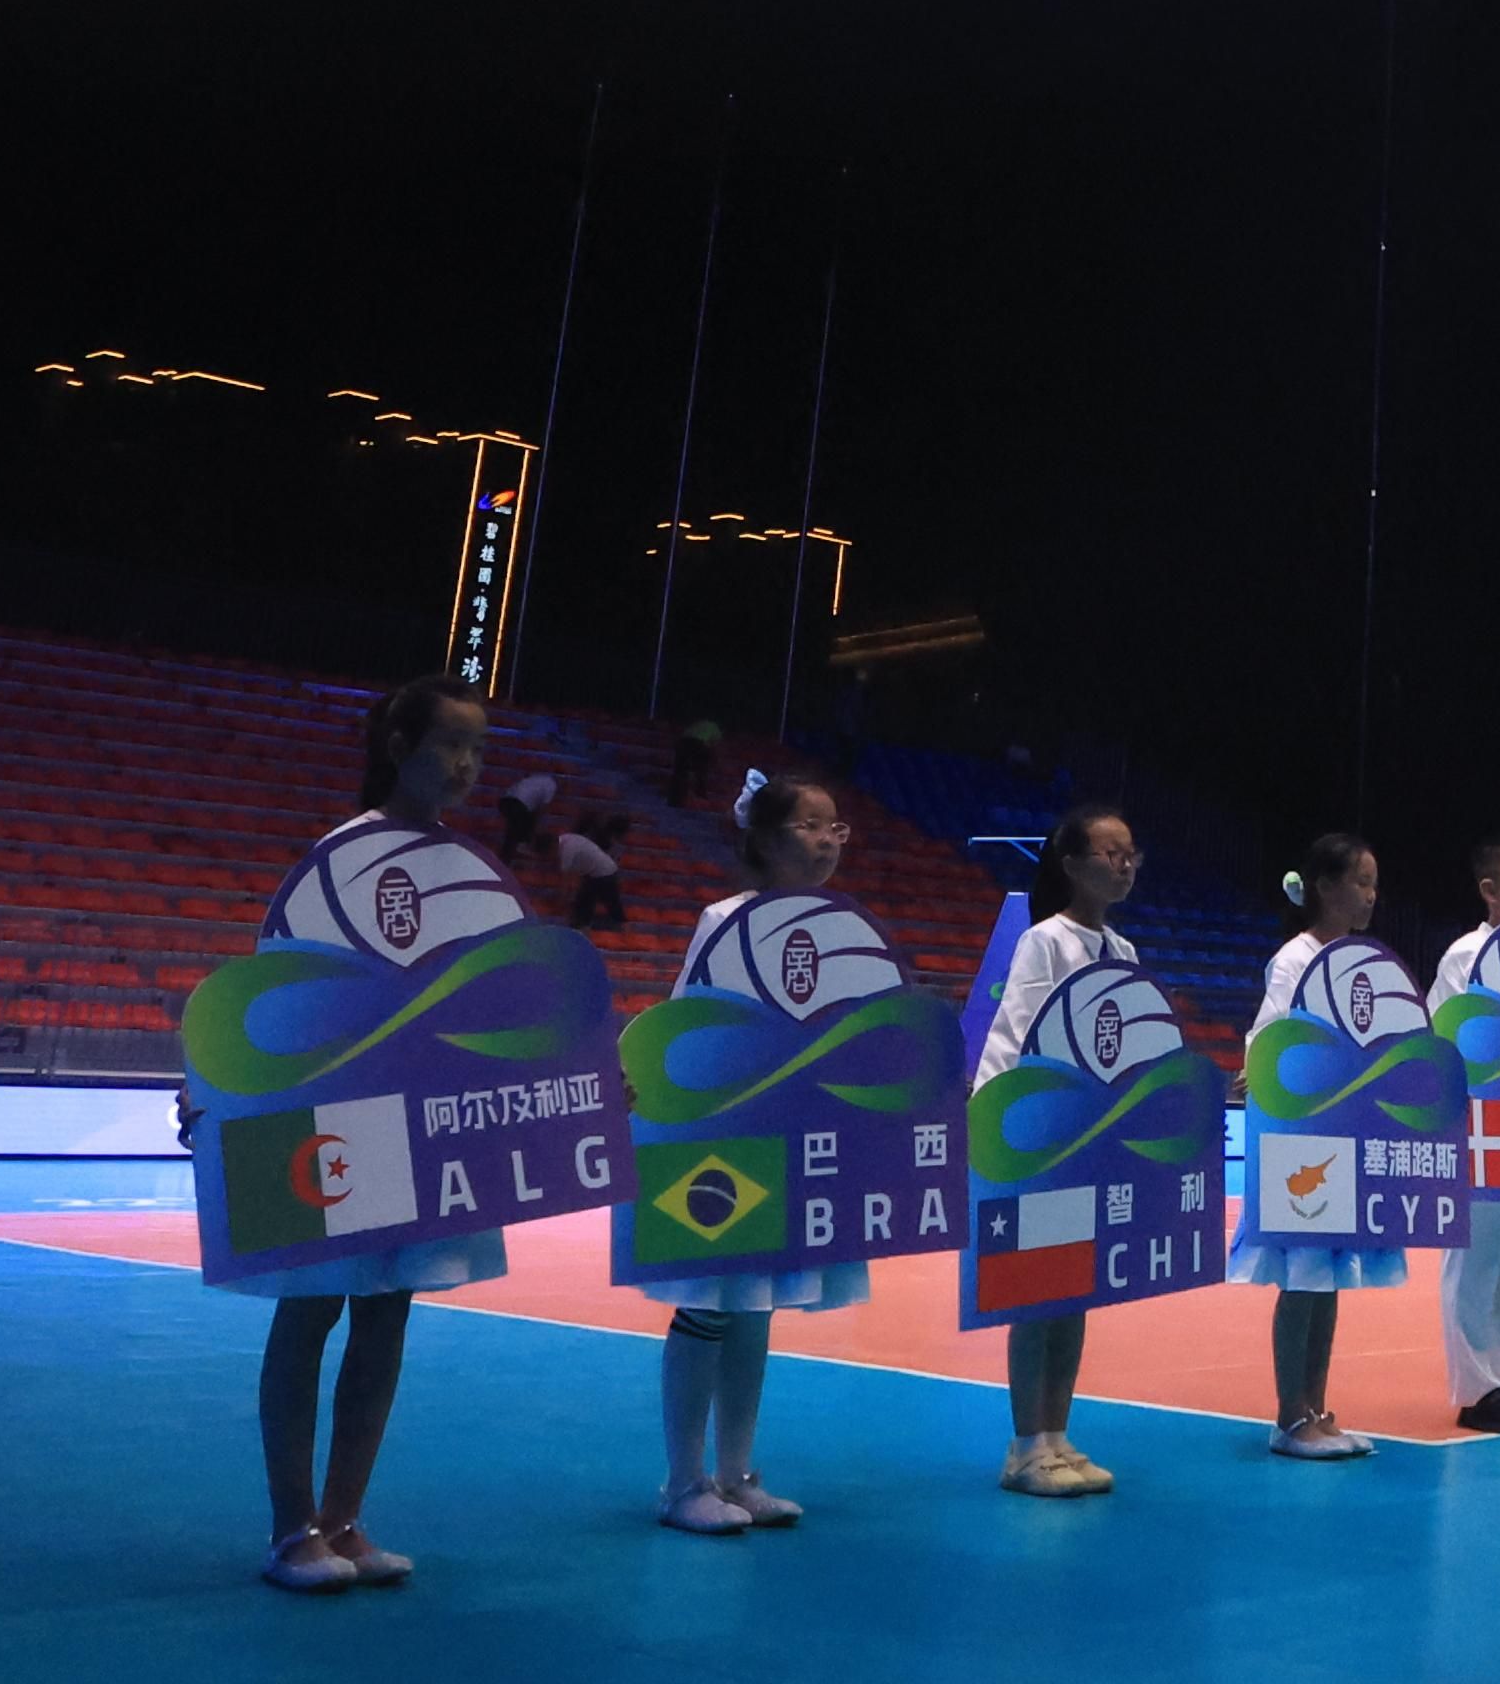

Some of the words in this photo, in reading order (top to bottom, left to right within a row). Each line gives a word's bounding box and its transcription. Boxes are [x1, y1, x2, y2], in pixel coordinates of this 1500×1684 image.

[423, 1072, 604, 1138] 阿尔及利亚
[439, 1136, 611, 1217] ALG
[804, 1124, 948, 1176] 巴西
[1364, 1138, 1457, 1179] 塞浦路斯
[806, 1188, 948, 1247] BRA
[1106, 1171, 1204, 1225] 智利
[1367, 1193, 1455, 1235] CYP
[1108, 1230, 1200, 1289] CHI
